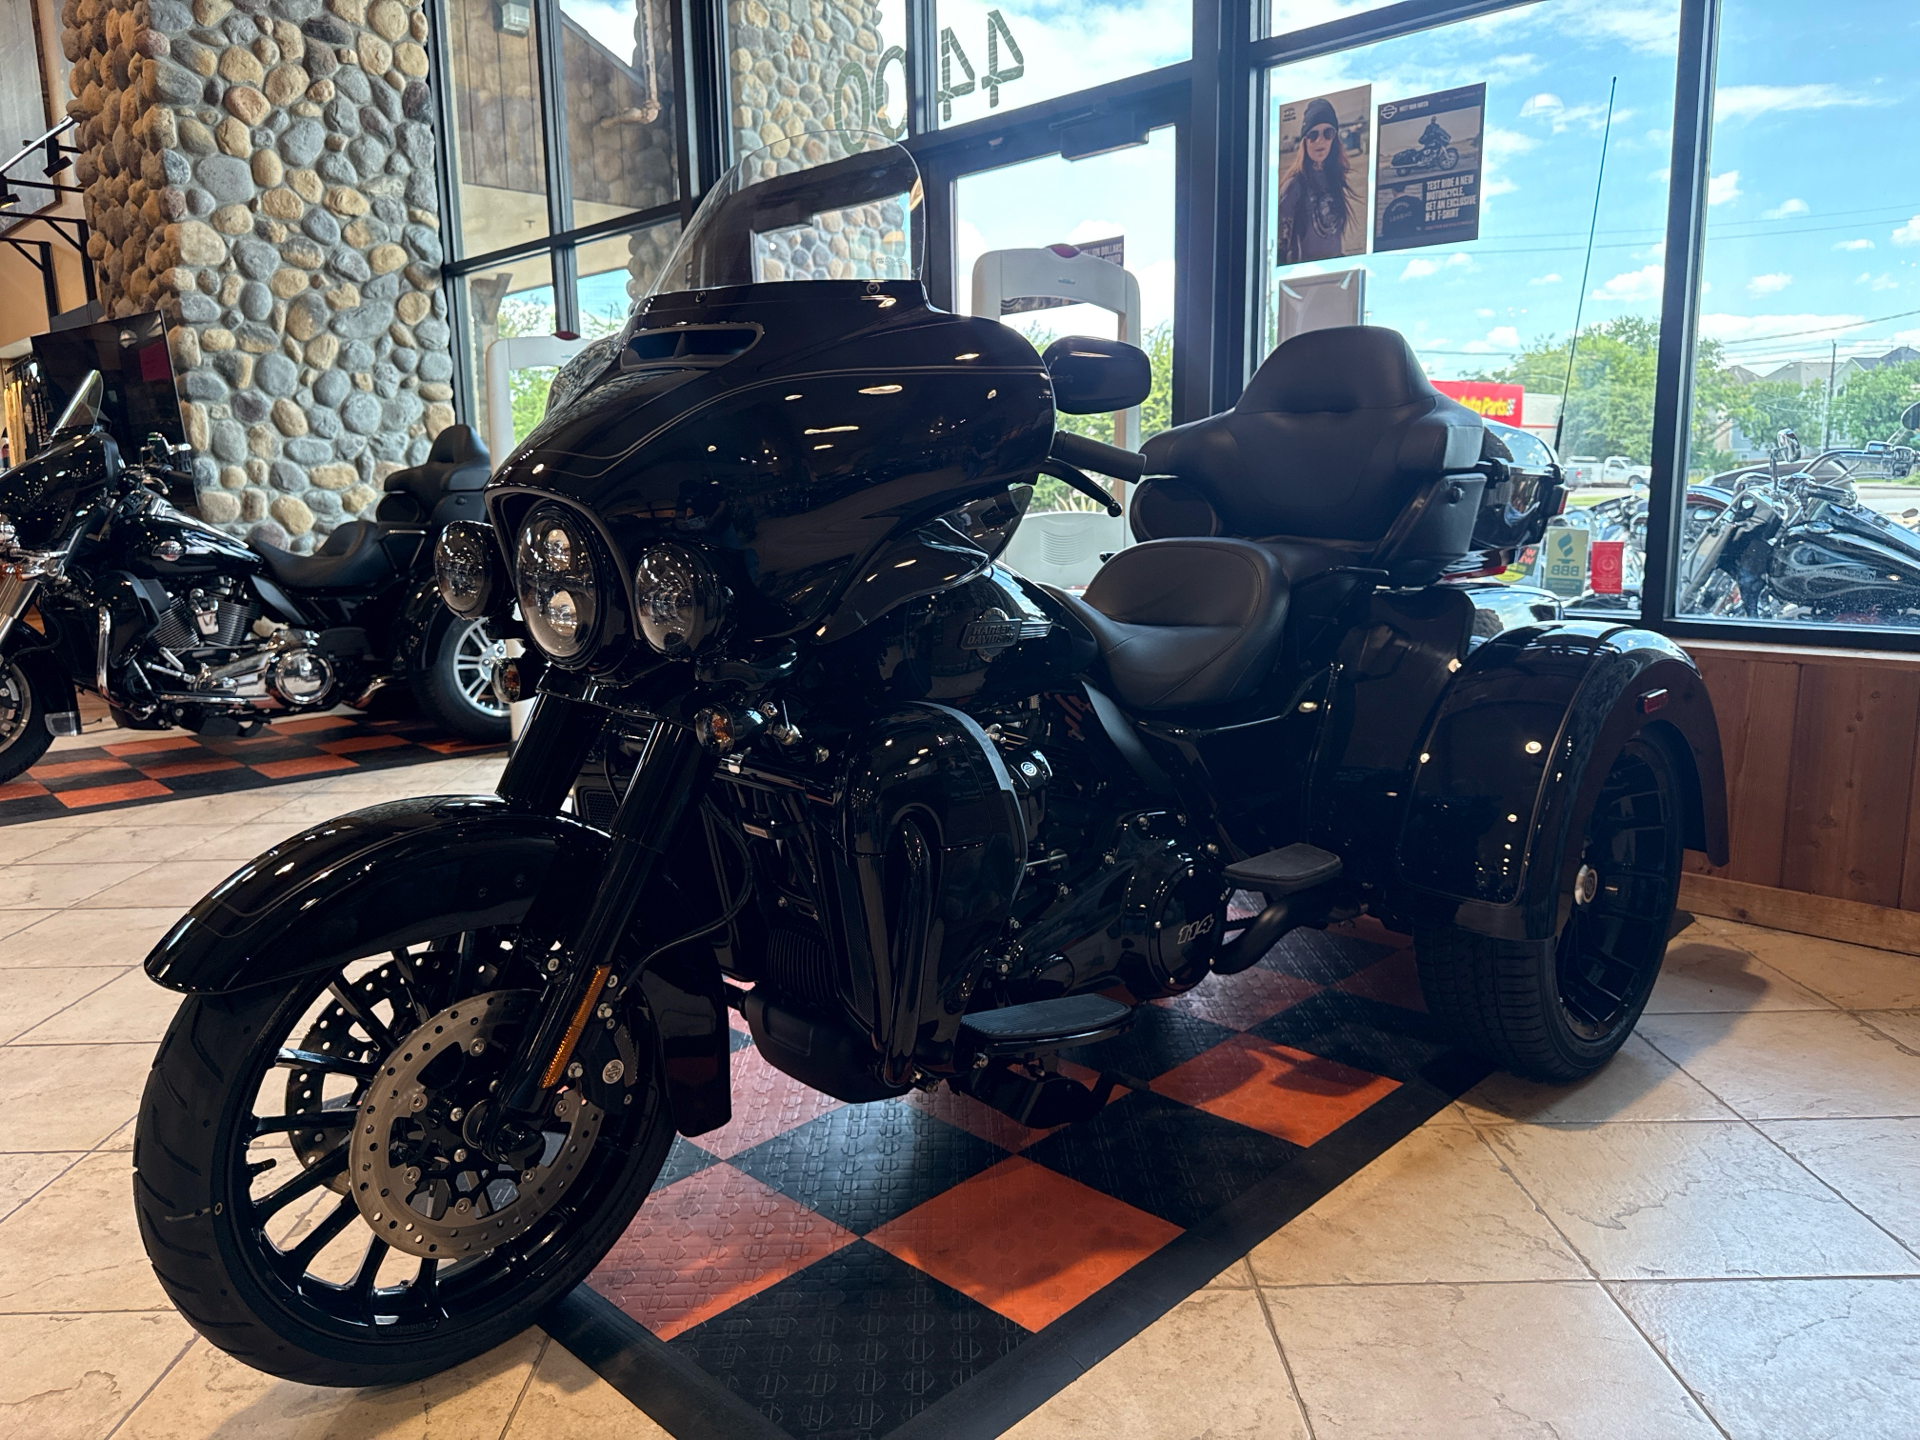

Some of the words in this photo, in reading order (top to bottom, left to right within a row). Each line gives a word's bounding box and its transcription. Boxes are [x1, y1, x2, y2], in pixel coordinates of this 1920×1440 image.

[1426, 179, 1441, 191] TEST
[1460, 174, 1474, 185] NEW
[1425, 200, 1437, 211] GET
[1437, 199, 1446, 210] AN
[1446, 194, 1477, 208] EXCLUSIVE
[967, 633, 1016, 645] DAVIDSON
[1177, 913, 1215, 945] 114
